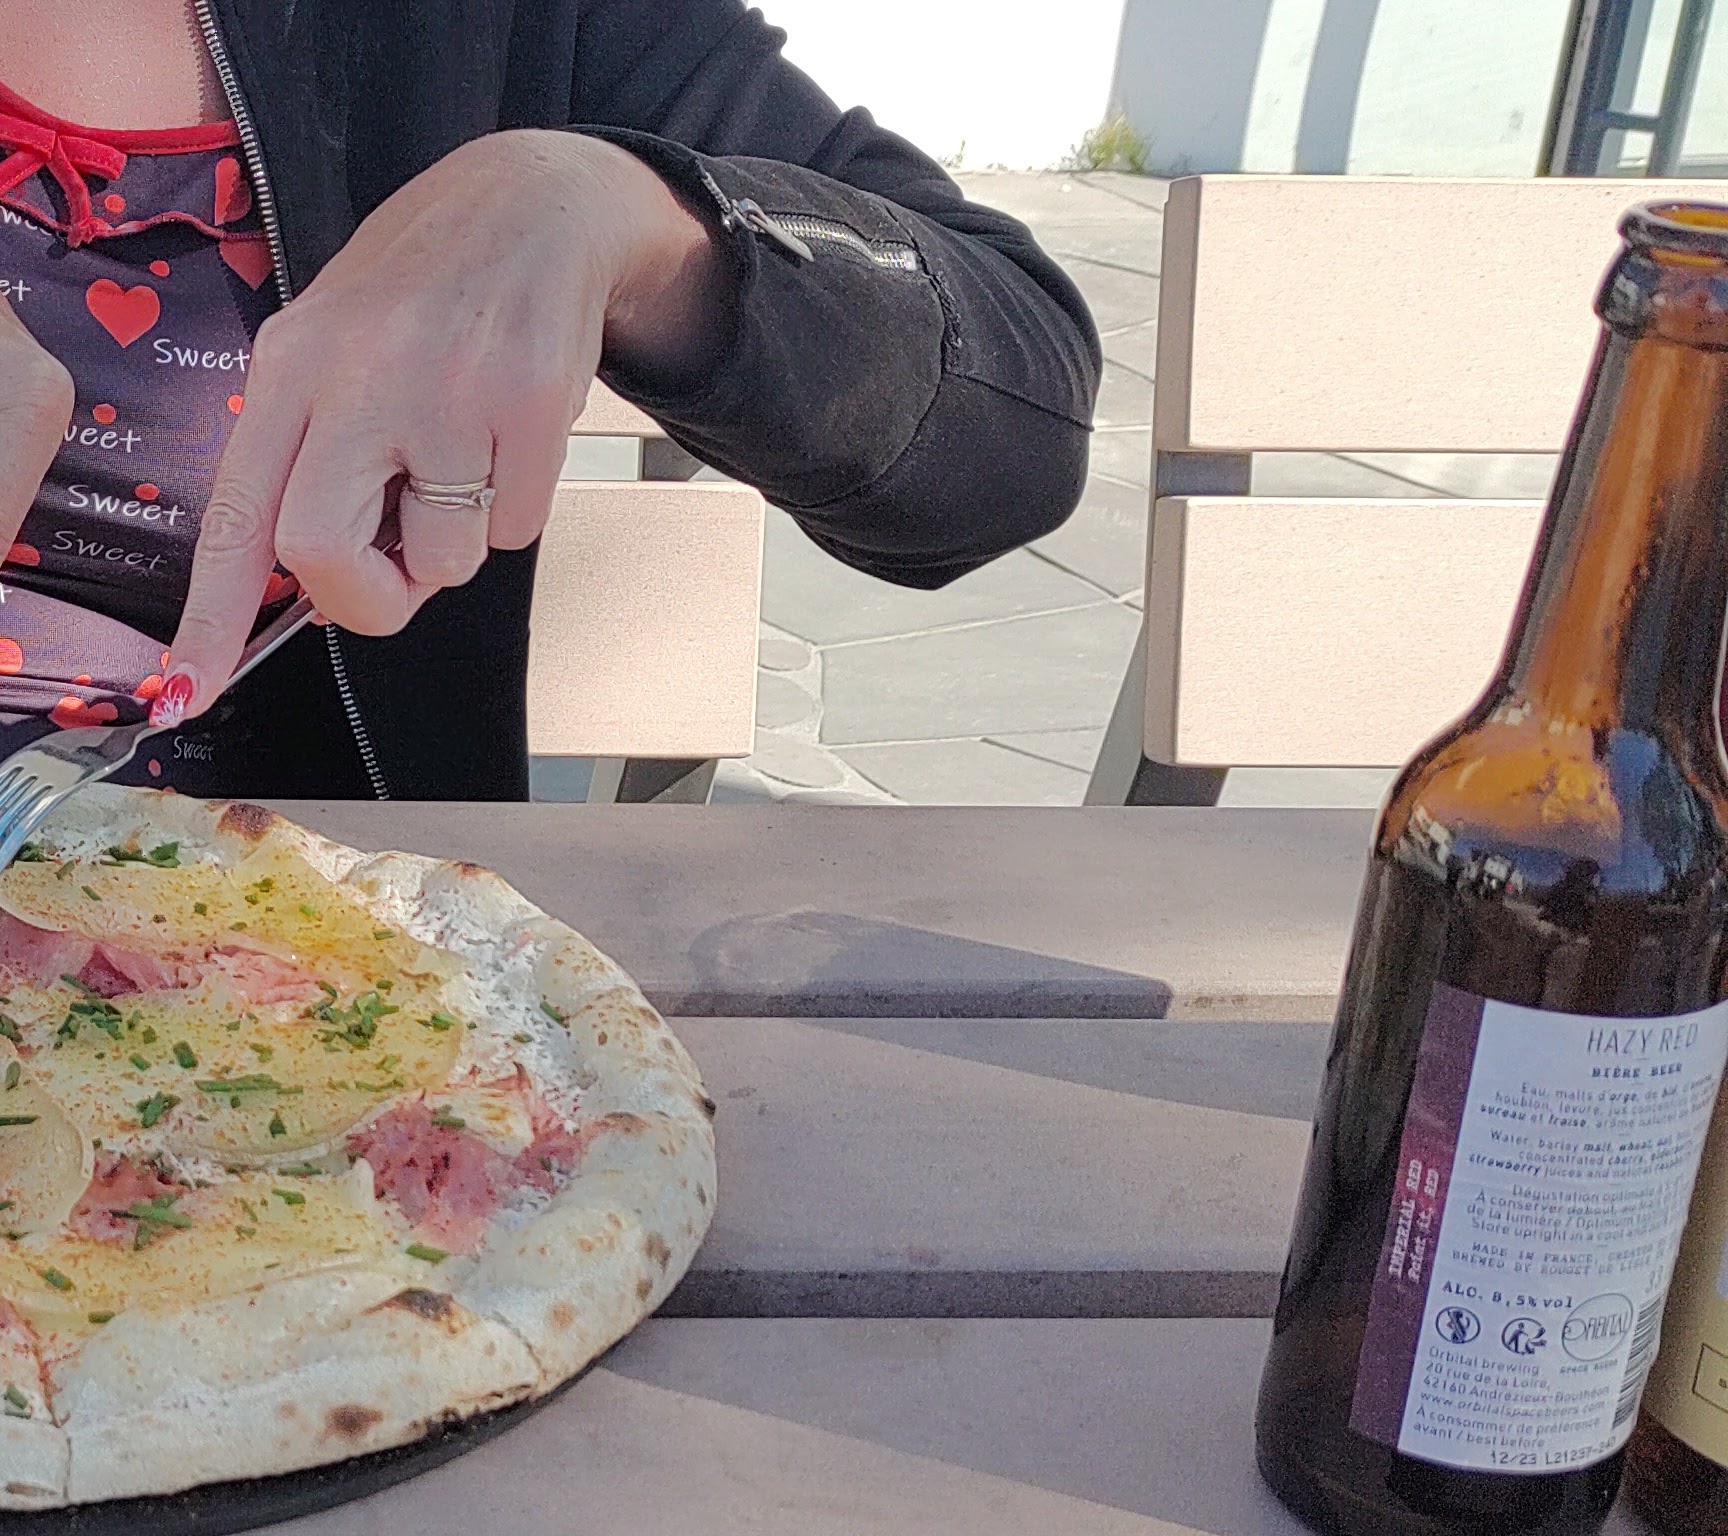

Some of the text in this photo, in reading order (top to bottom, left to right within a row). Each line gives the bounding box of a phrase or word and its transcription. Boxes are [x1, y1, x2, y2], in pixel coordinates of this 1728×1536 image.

[153, 338, 251, 372] Sweet
[64, 425, 142, 454] eet
[67, 484, 187, 526] Sweet
[52, 530, 168, 570] Sweet
[174, 735, 216, 762] Sweet
[1586, 1022, 1699, 1055] HAZY RED
[1468, 1153, 1542, 1177] strawberry
[1543, 1295, 1573, 1309] vol
[1429, 1345, 1540, 1377] Orbital brewing
[1413, 1421, 1452, 1440] avant
[1491, 1449, 1537, 1465] 12/23
